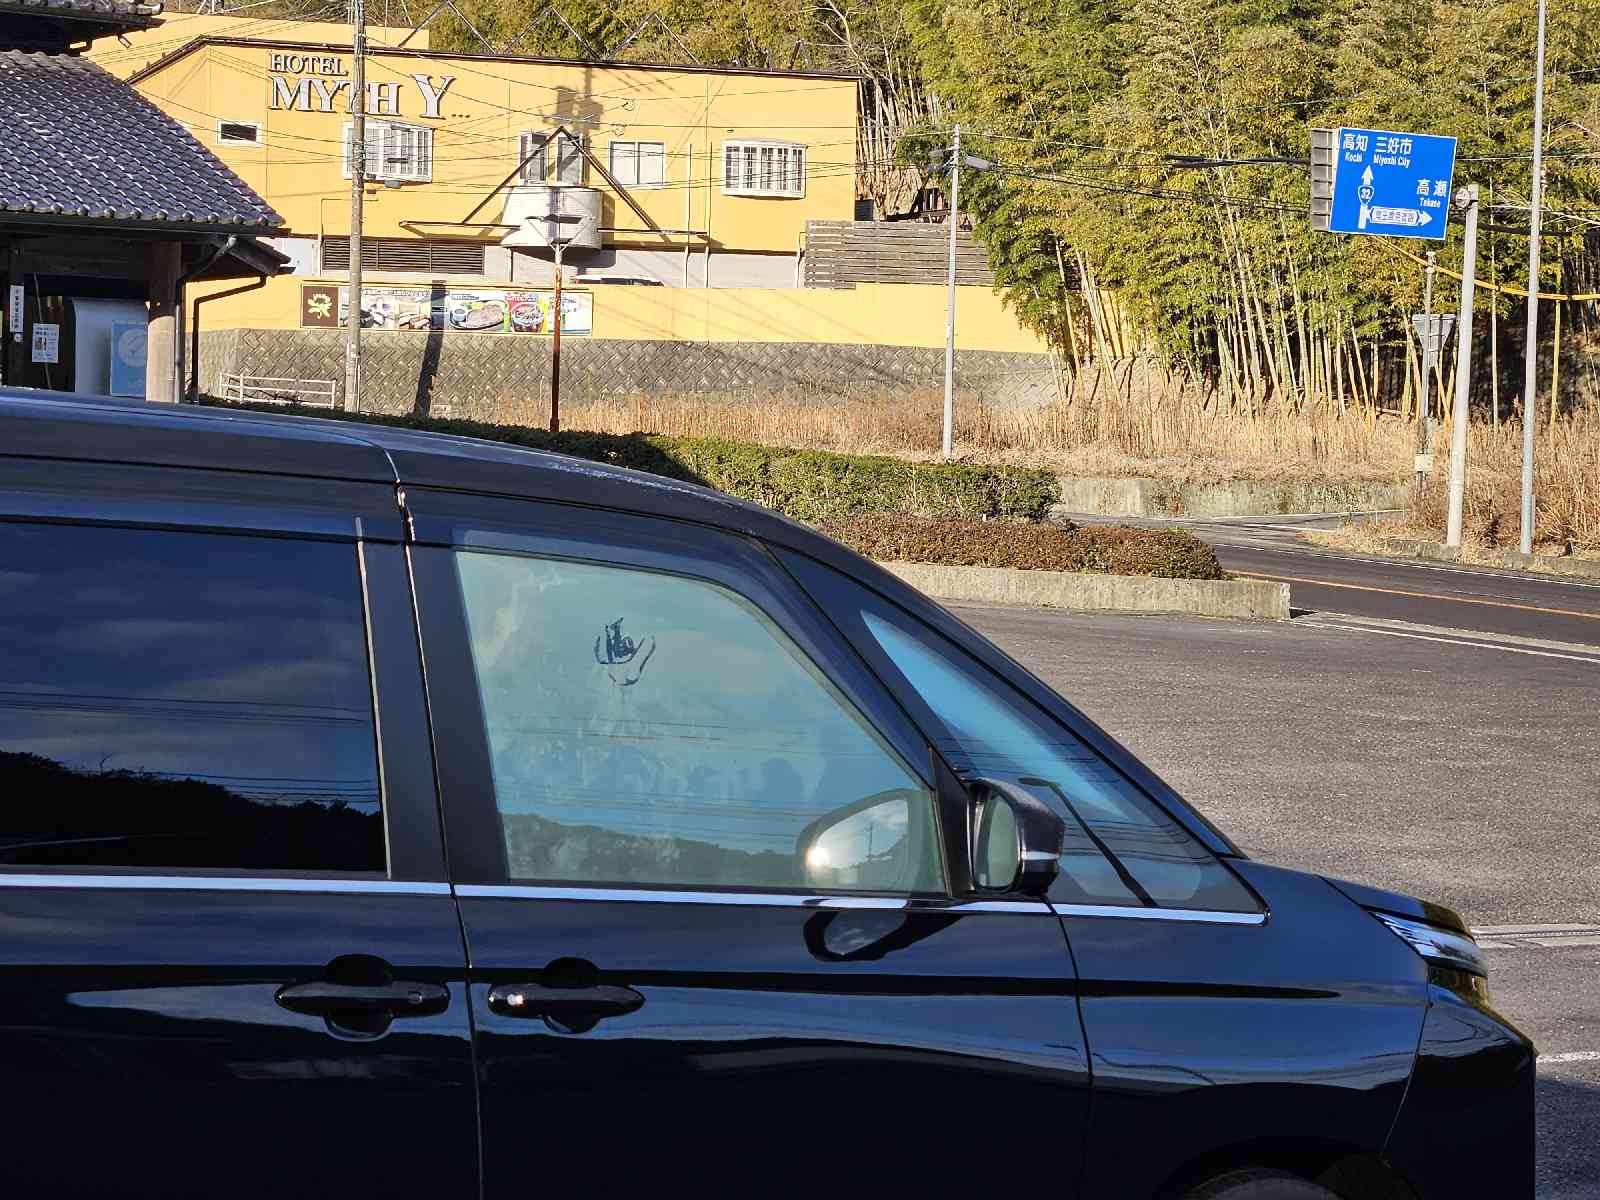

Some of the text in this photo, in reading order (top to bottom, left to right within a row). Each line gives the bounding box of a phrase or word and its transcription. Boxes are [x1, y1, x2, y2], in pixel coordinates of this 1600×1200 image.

[270, 53, 349, 76] HOTEL
[411, 73, 456, 119] Y
[1343, 134, 1413, 154] 高知 三好市
[1361, 188, 1371, 199] 32
